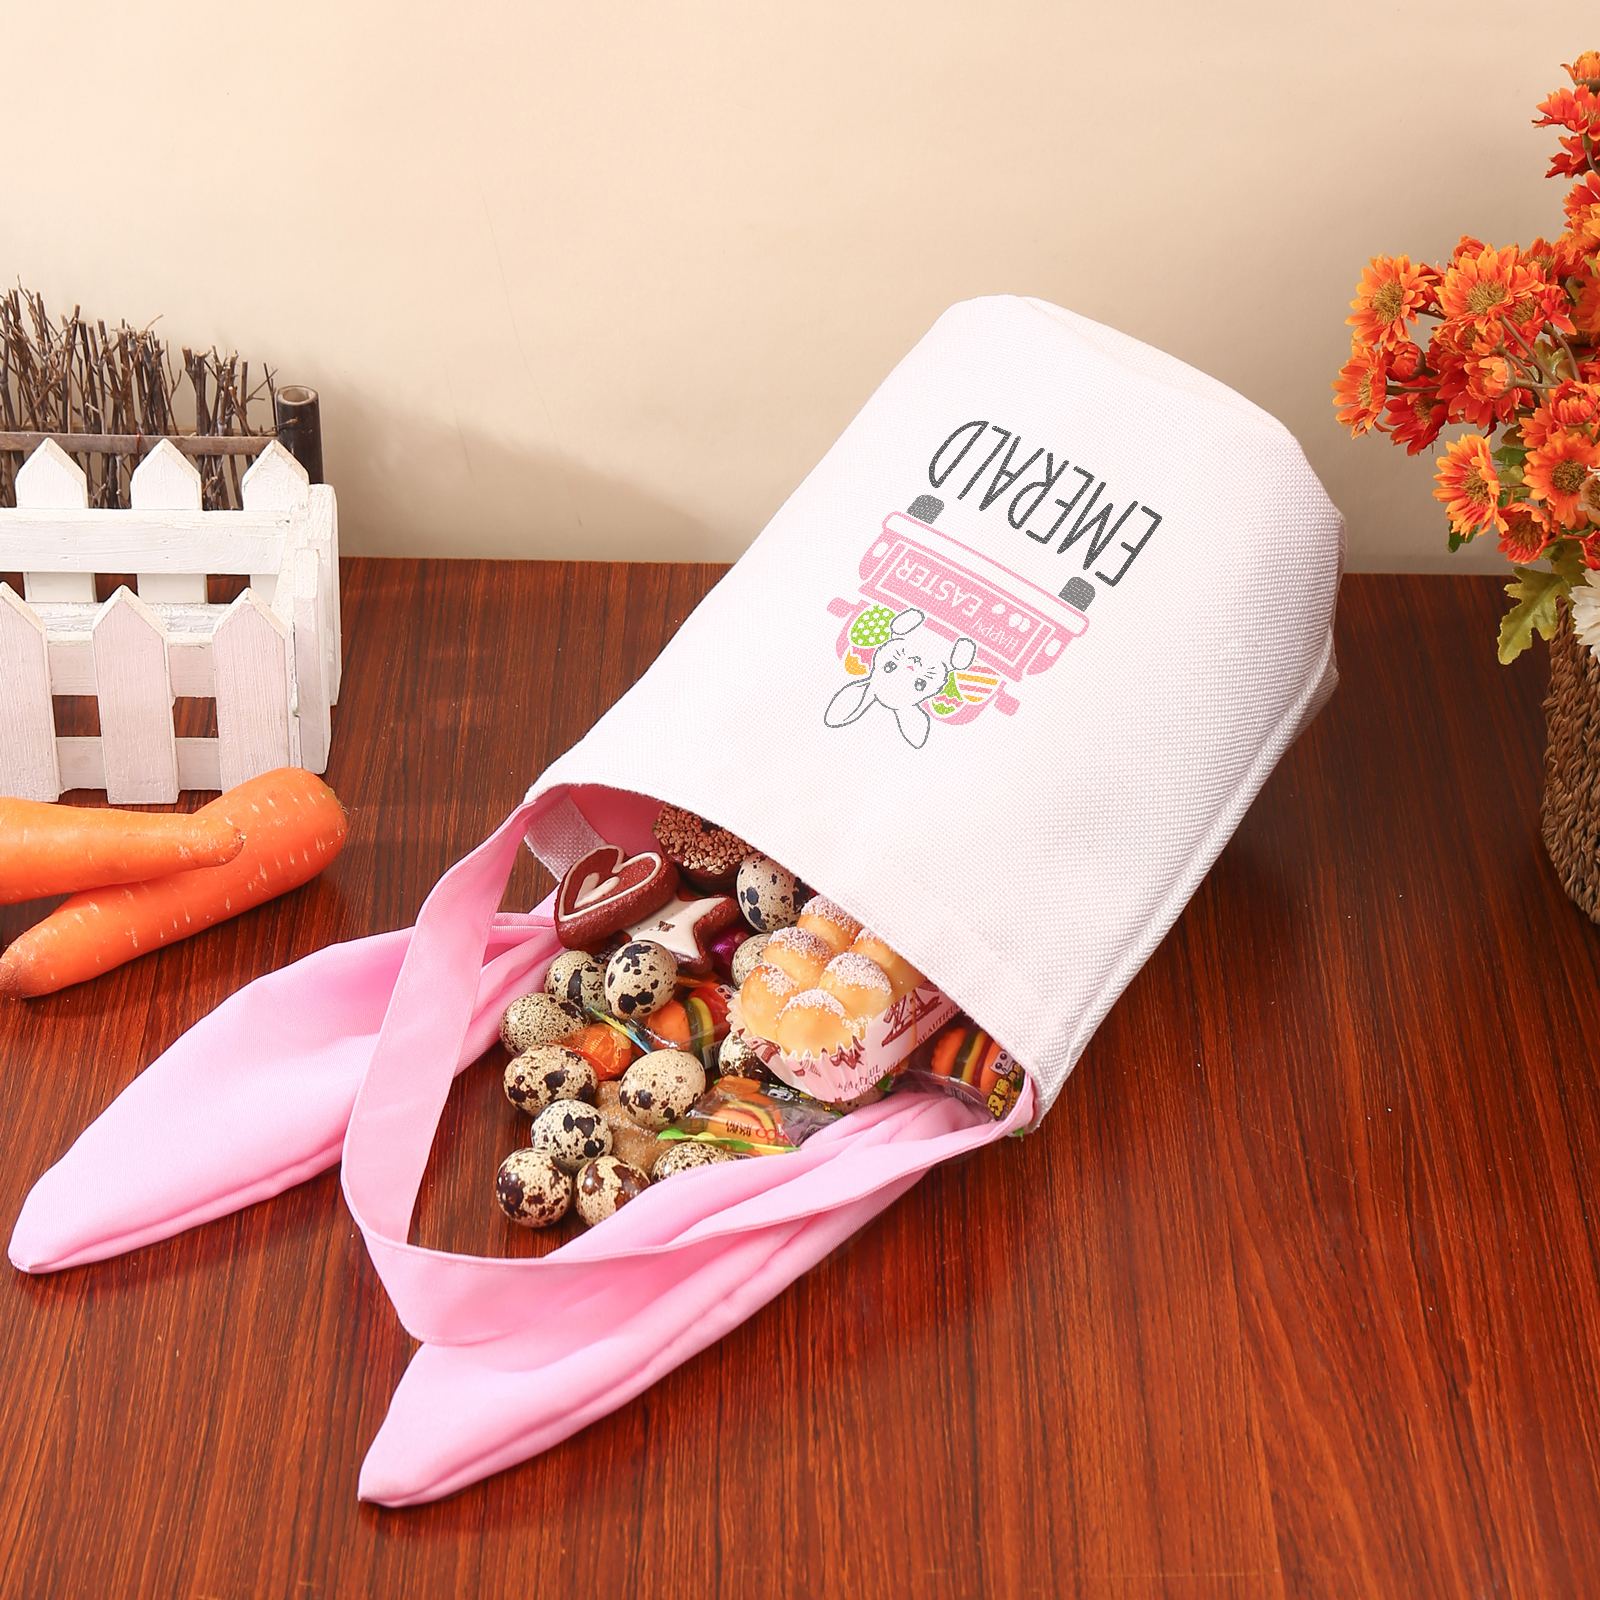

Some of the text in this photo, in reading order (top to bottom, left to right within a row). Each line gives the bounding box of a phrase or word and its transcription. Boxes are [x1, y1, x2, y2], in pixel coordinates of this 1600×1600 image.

[928, 420, 1162, 587] EMERALD
[895, 558, 1020, 651] HAPPY EASTER
